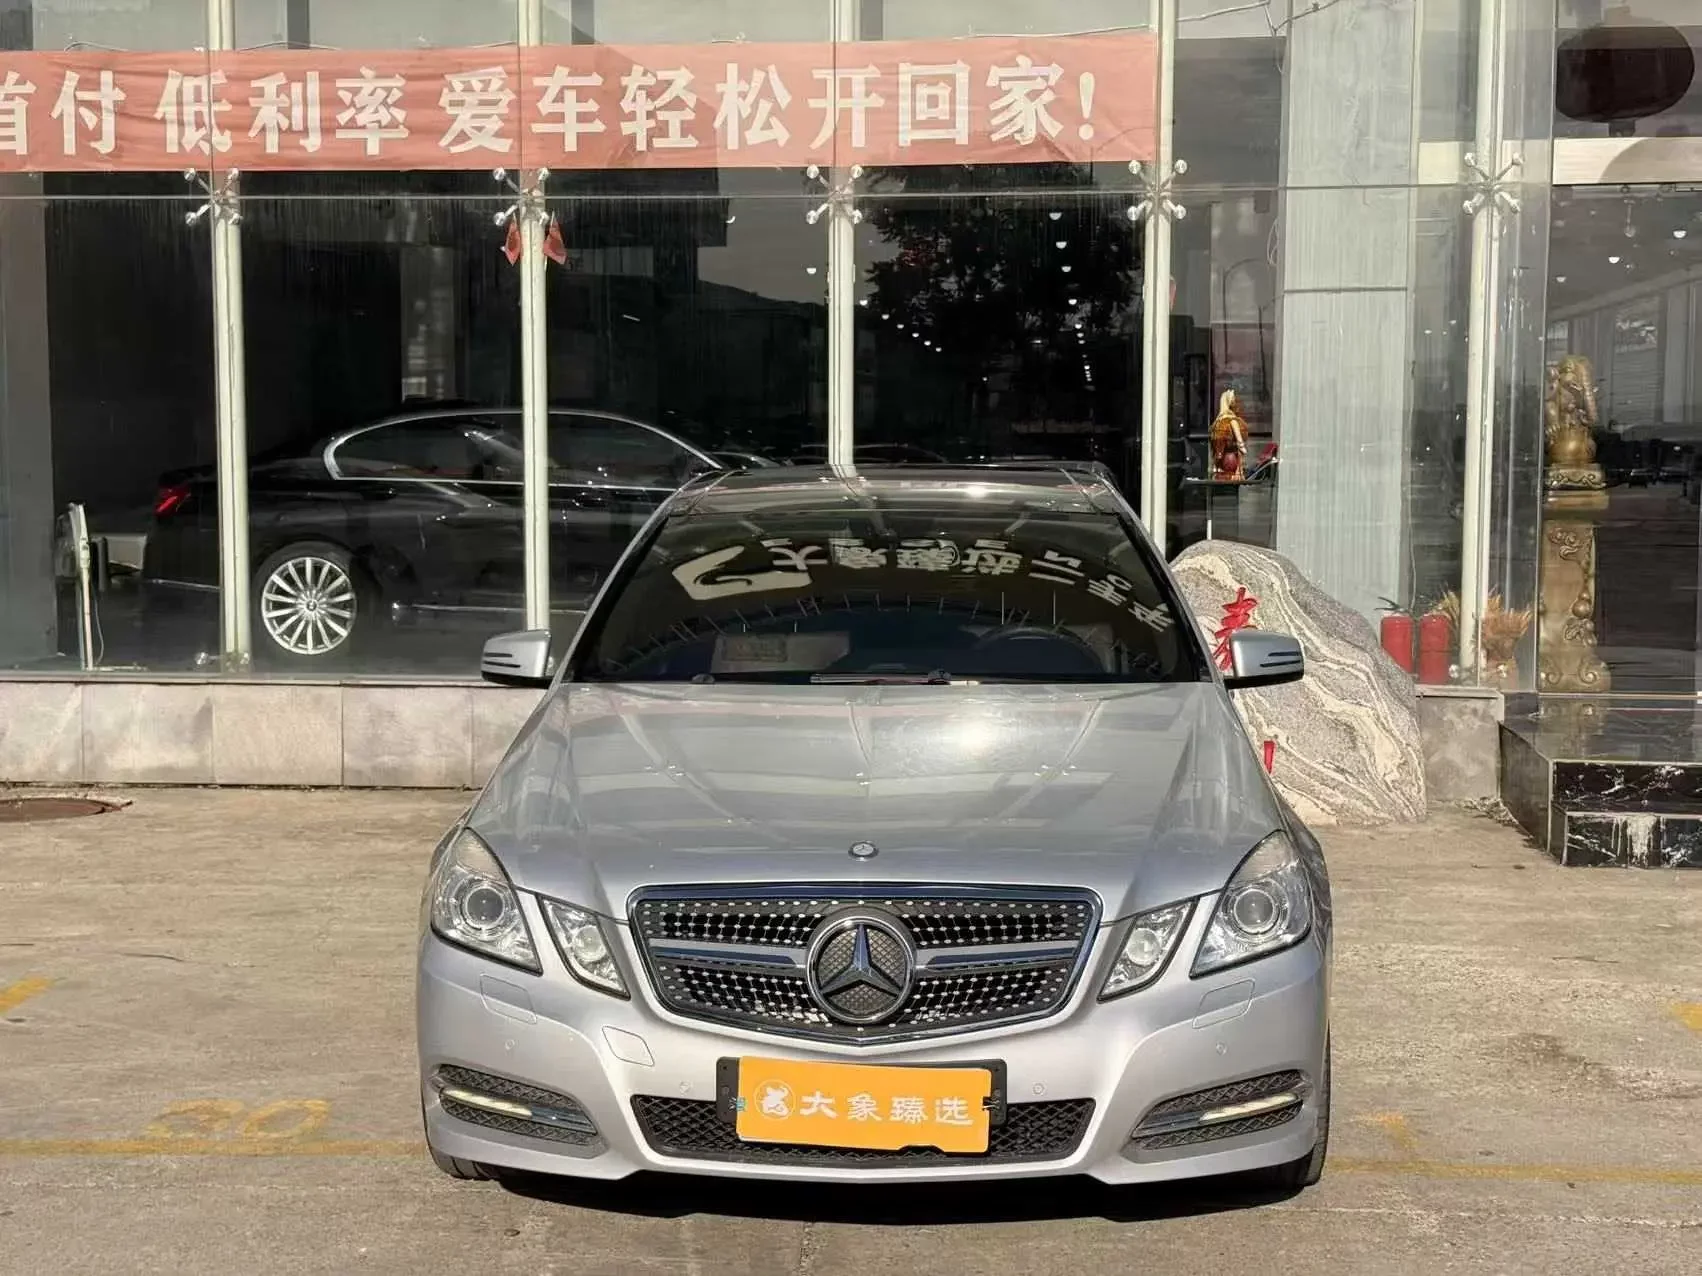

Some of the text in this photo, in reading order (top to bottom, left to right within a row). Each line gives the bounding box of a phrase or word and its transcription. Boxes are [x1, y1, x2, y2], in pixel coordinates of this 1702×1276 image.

[152, 66, 410, 156] 低利率
[436, 54, 1095, 154] 爱车轻松开回家!
[799, 1090, 975, 1126] 大象臻选
